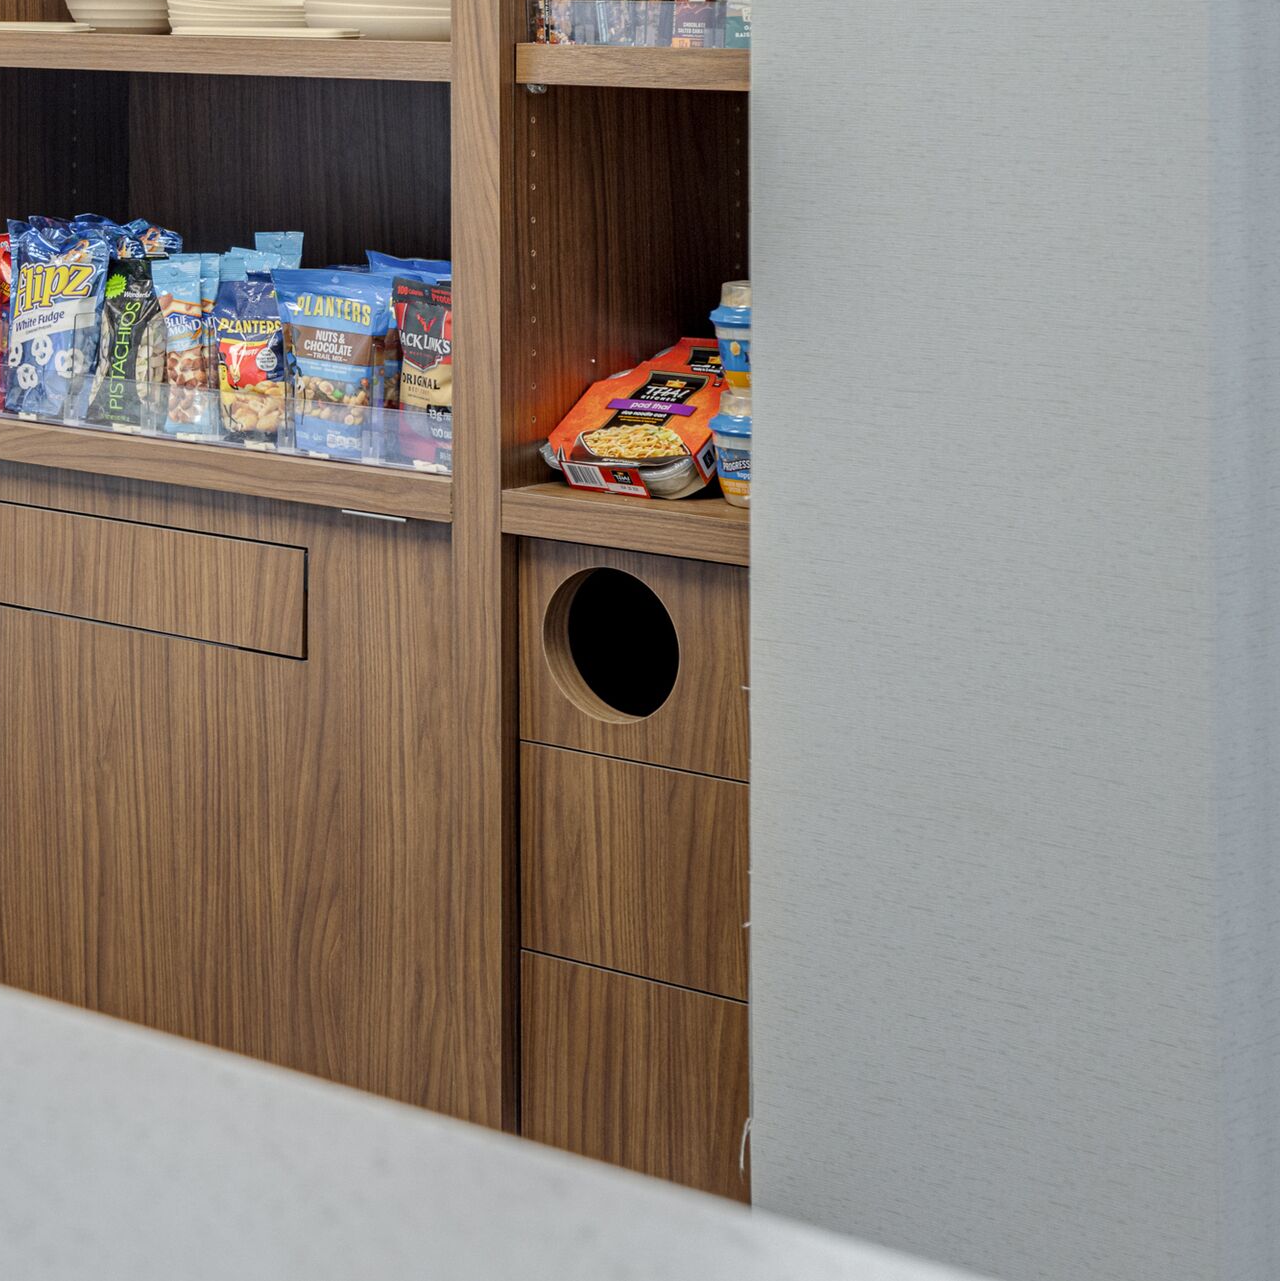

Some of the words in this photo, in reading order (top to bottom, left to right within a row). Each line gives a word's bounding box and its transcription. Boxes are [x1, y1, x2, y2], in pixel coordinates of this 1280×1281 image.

[296, 296, 372, 326] PLANTERS
[15, 317, 37, 332] White
[38, 310, 65, 325] Fudge
[165, 316, 188, 328] BLUE
[217, 318, 282, 335] PLANTERS
[315, 330, 337, 342] NUTS
[338, 333, 346, 344] &
[424, 335, 451, 355] LINK'S
[109, 301, 141, 410] PISTACHIOS
[304, 339, 353, 357] CHOCOLATE
[313, 352, 331, 361] TRAIL
[332, 354, 343, 362] MIX
[646, 385, 691, 399] THAI
[652, 401, 672, 411] thai
